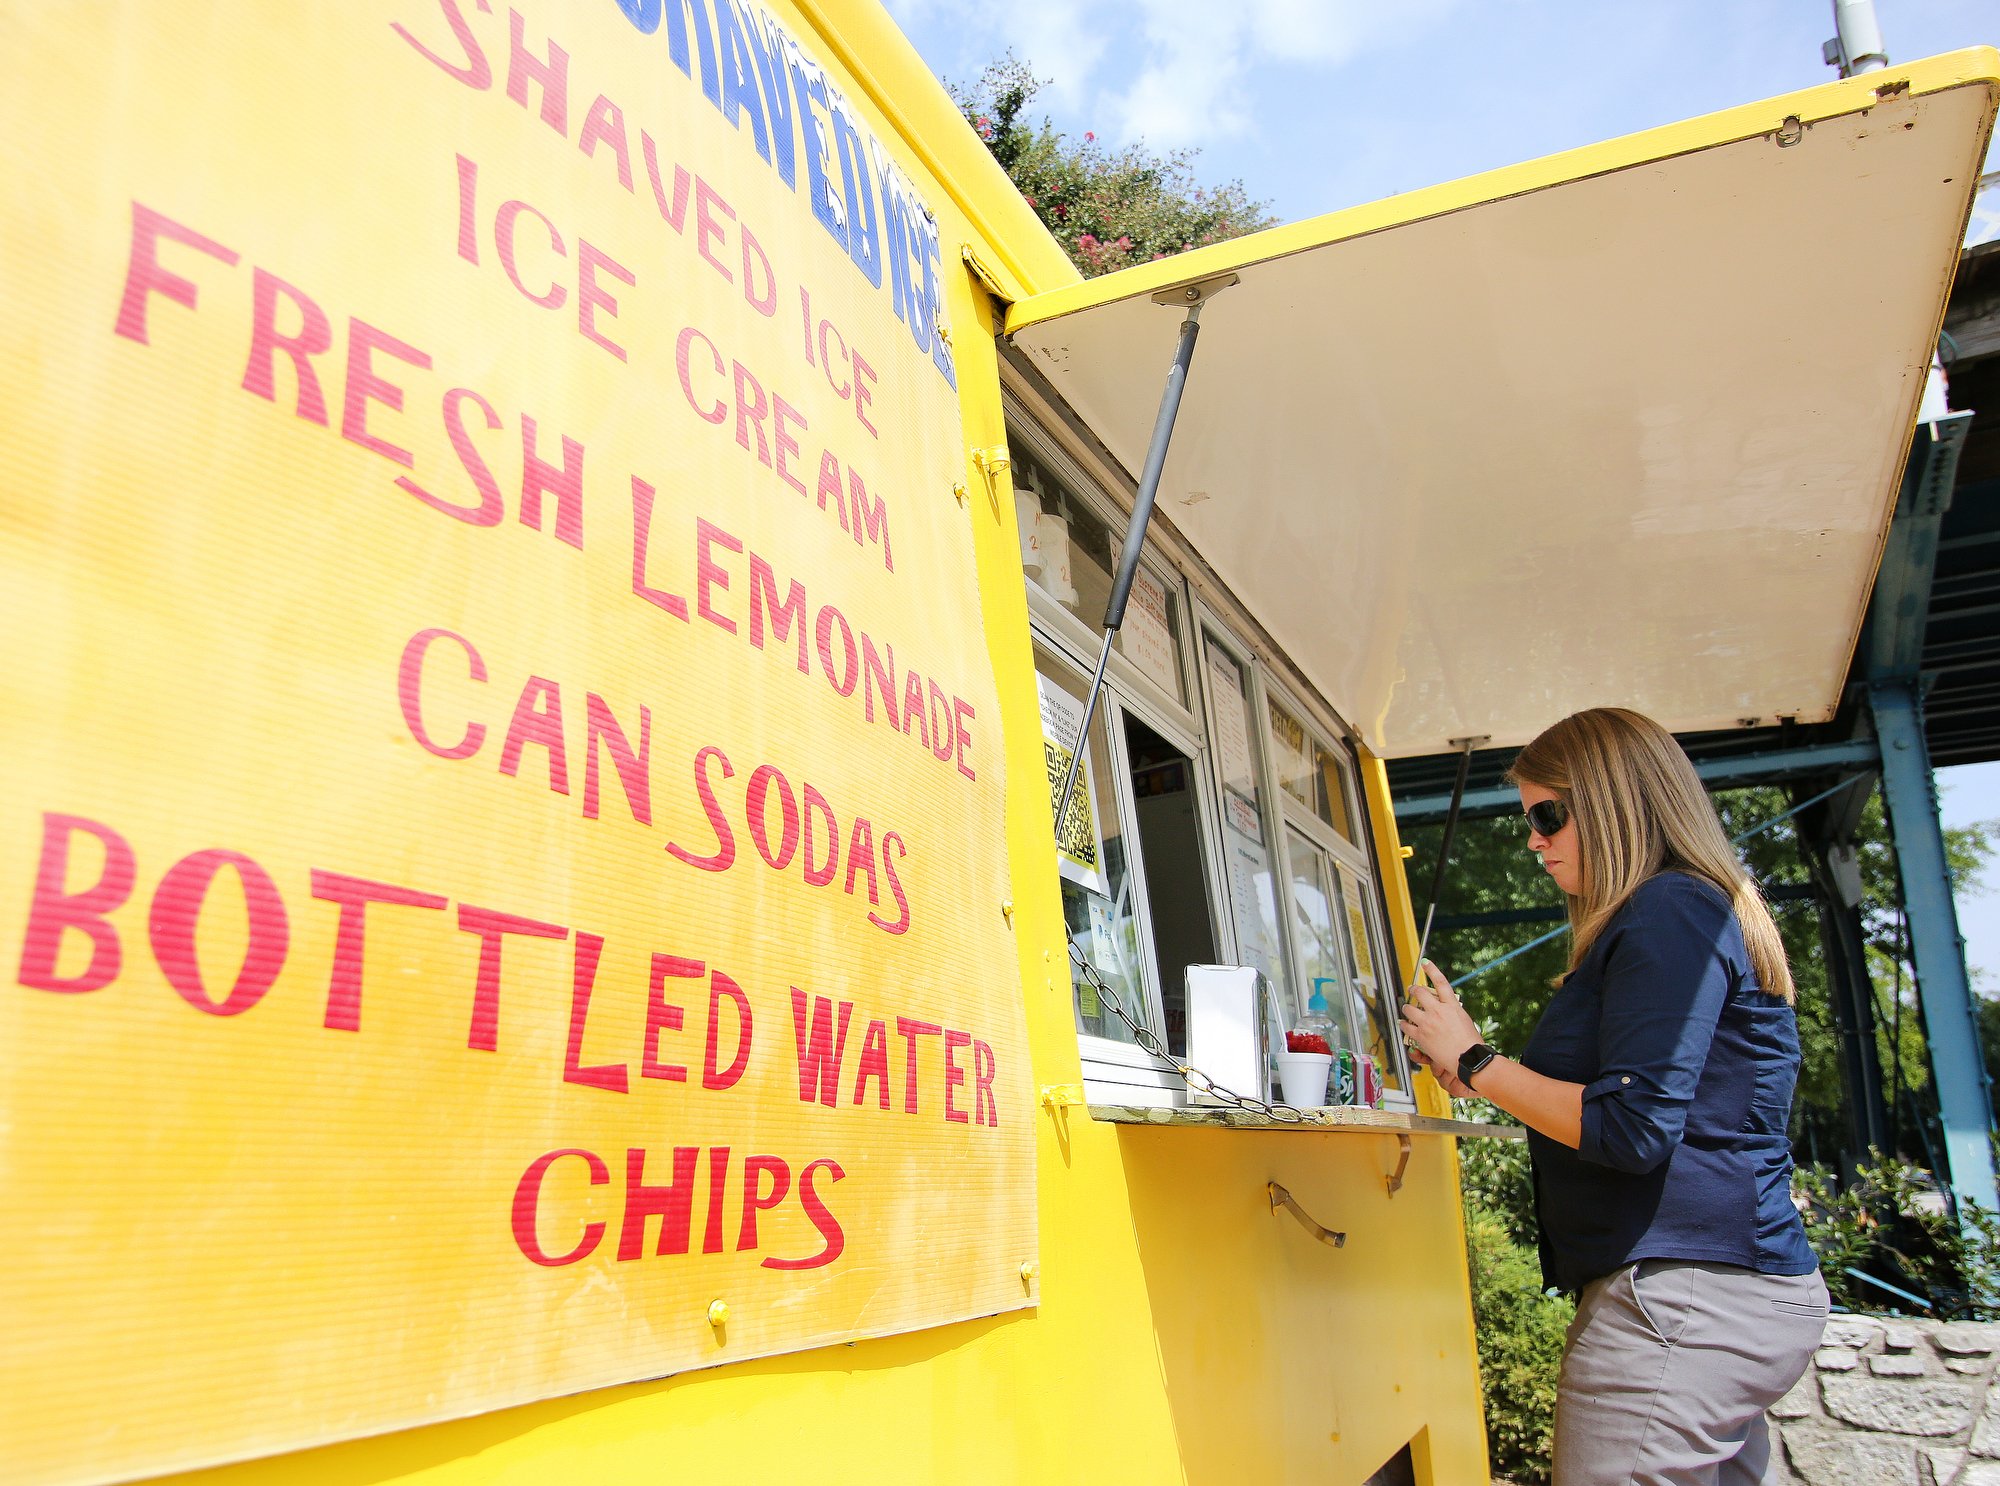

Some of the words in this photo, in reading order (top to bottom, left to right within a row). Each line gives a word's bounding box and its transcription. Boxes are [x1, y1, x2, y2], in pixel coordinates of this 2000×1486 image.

[390, 0, 778, 317] SHAVED
[799, 284, 879, 440] ICE
[456, 152, 636, 364] ICE
[675, 327, 895, 573] CREAM
[614, 0, 883, 290] HAVED
[868, 134, 957, 393] ICE
[114, 200, 584, 551] FRESH
[632, 474, 977, 783] LEMONADE
[16, 810, 755, 1094] BOTTLED
[789, 984, 999, 1129] WATER
[397, 627, 653, 827] CAN
[664, 744, 912, 936] SODAS
[511, 1145, 846, 1272] CHIPS
